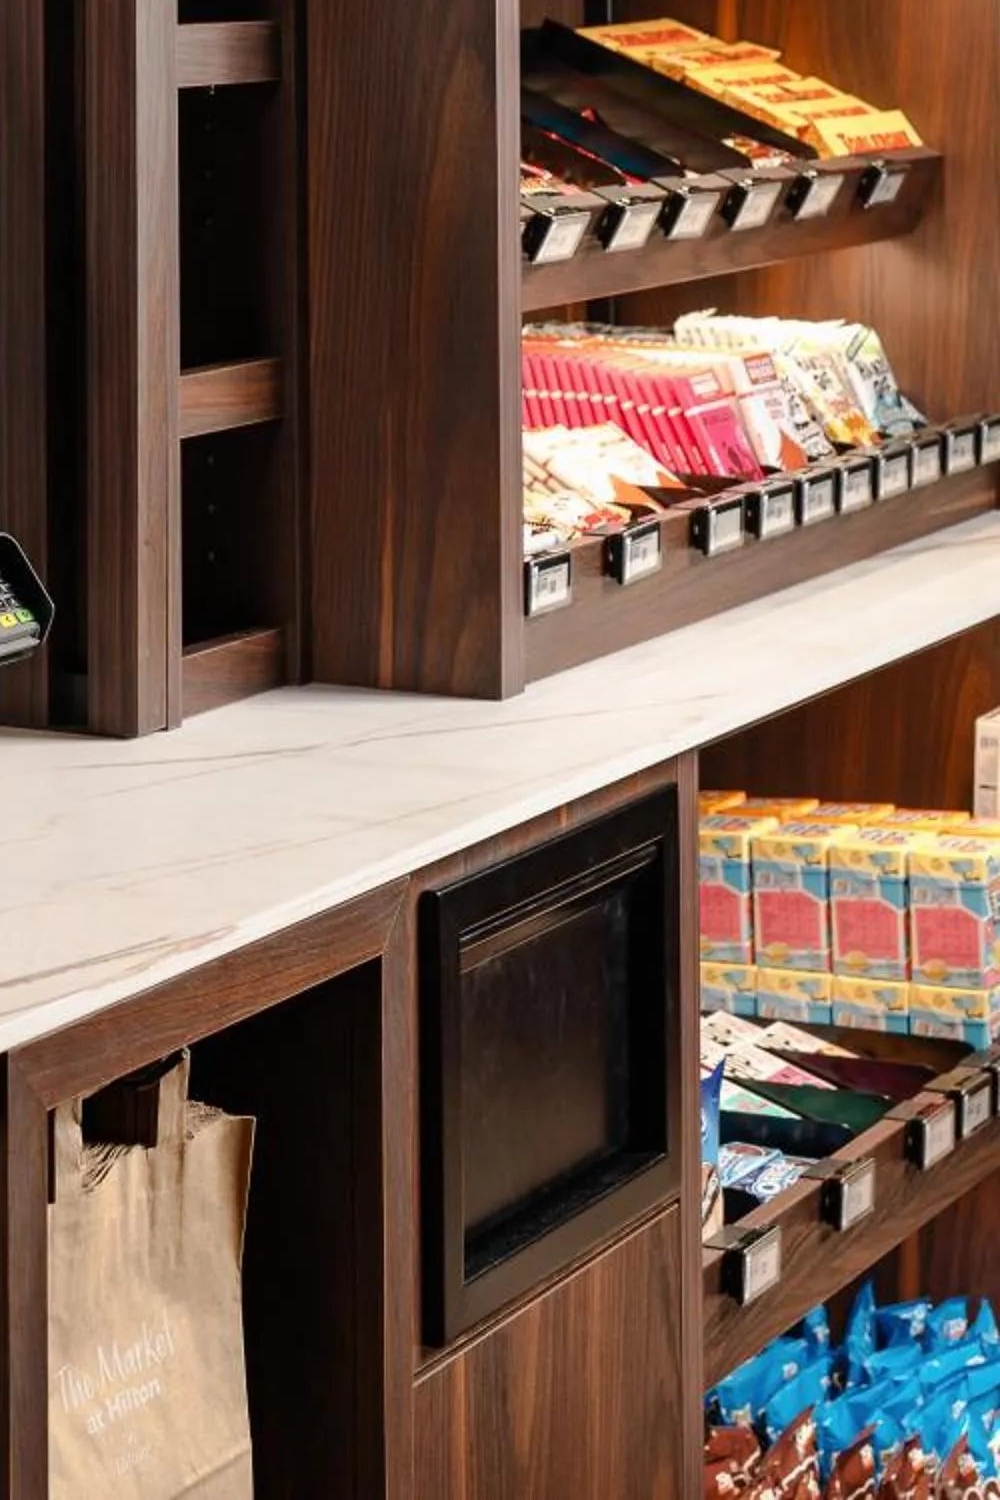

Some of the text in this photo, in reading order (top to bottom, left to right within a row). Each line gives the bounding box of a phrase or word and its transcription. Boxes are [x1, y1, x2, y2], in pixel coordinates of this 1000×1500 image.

[57, 1306, 174, 1414] The Market
[104, 1378, 161, 1420] Hilton
